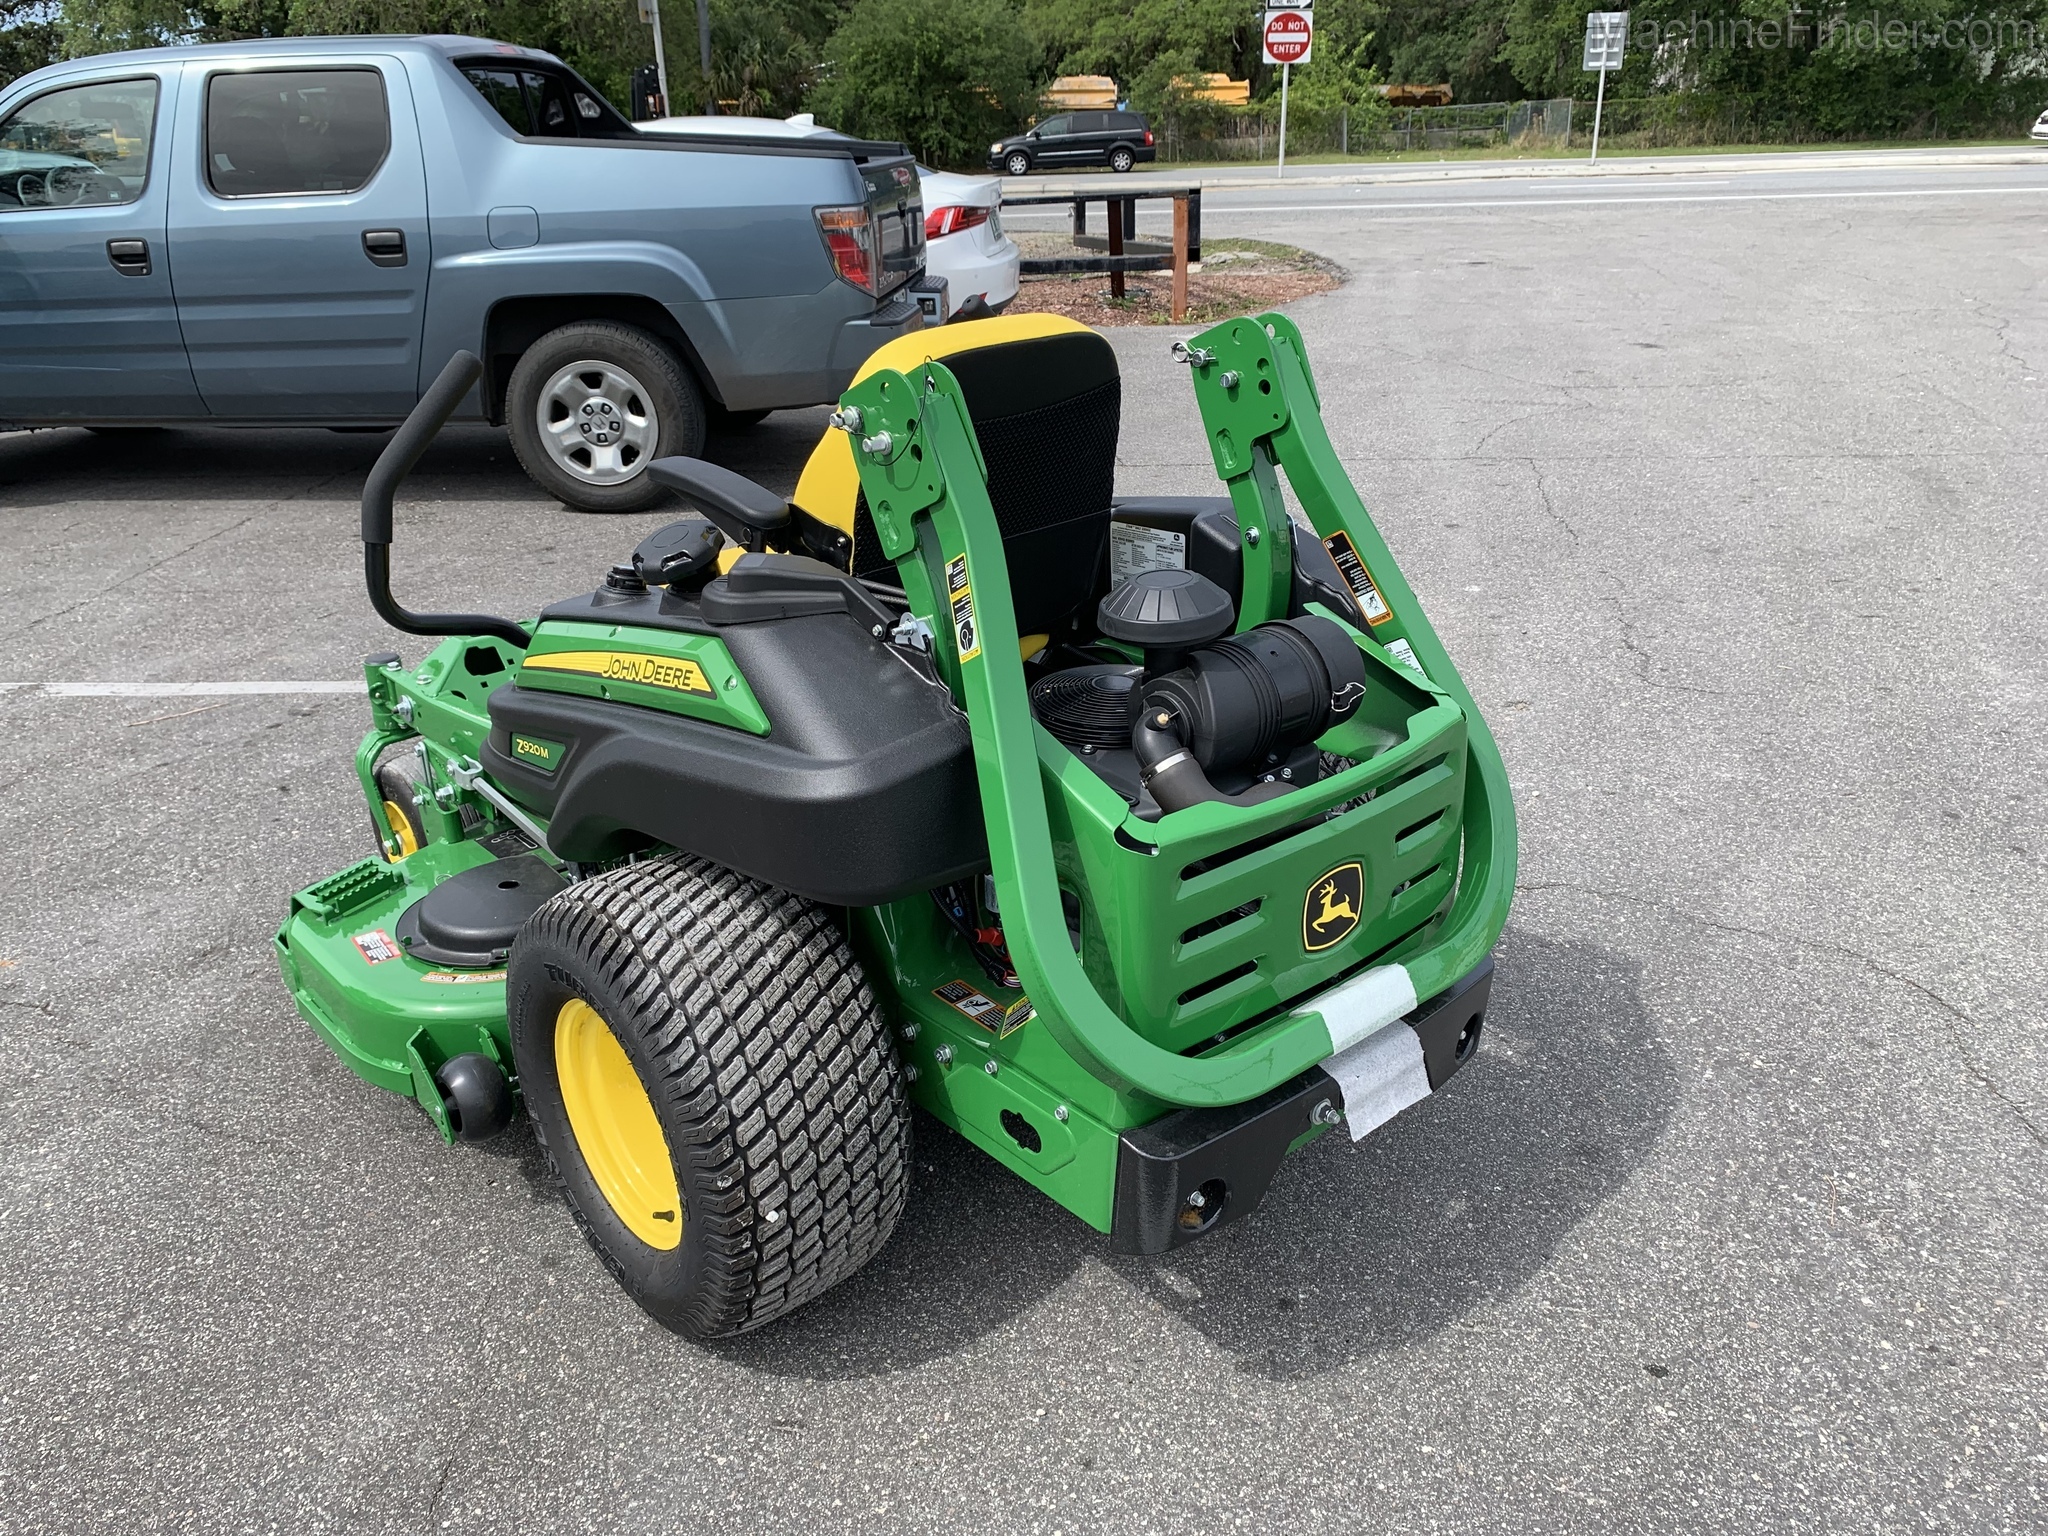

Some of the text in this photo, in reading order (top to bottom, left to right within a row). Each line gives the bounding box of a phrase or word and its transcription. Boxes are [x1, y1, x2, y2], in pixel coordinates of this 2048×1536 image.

[1271, 21, 1305, 31] DO NOT
[1273, 44, 1301, 54] ENTER
[602, 655, 694, 687] JOHN DEERE
[516, 738, 549, 760] Z920M
